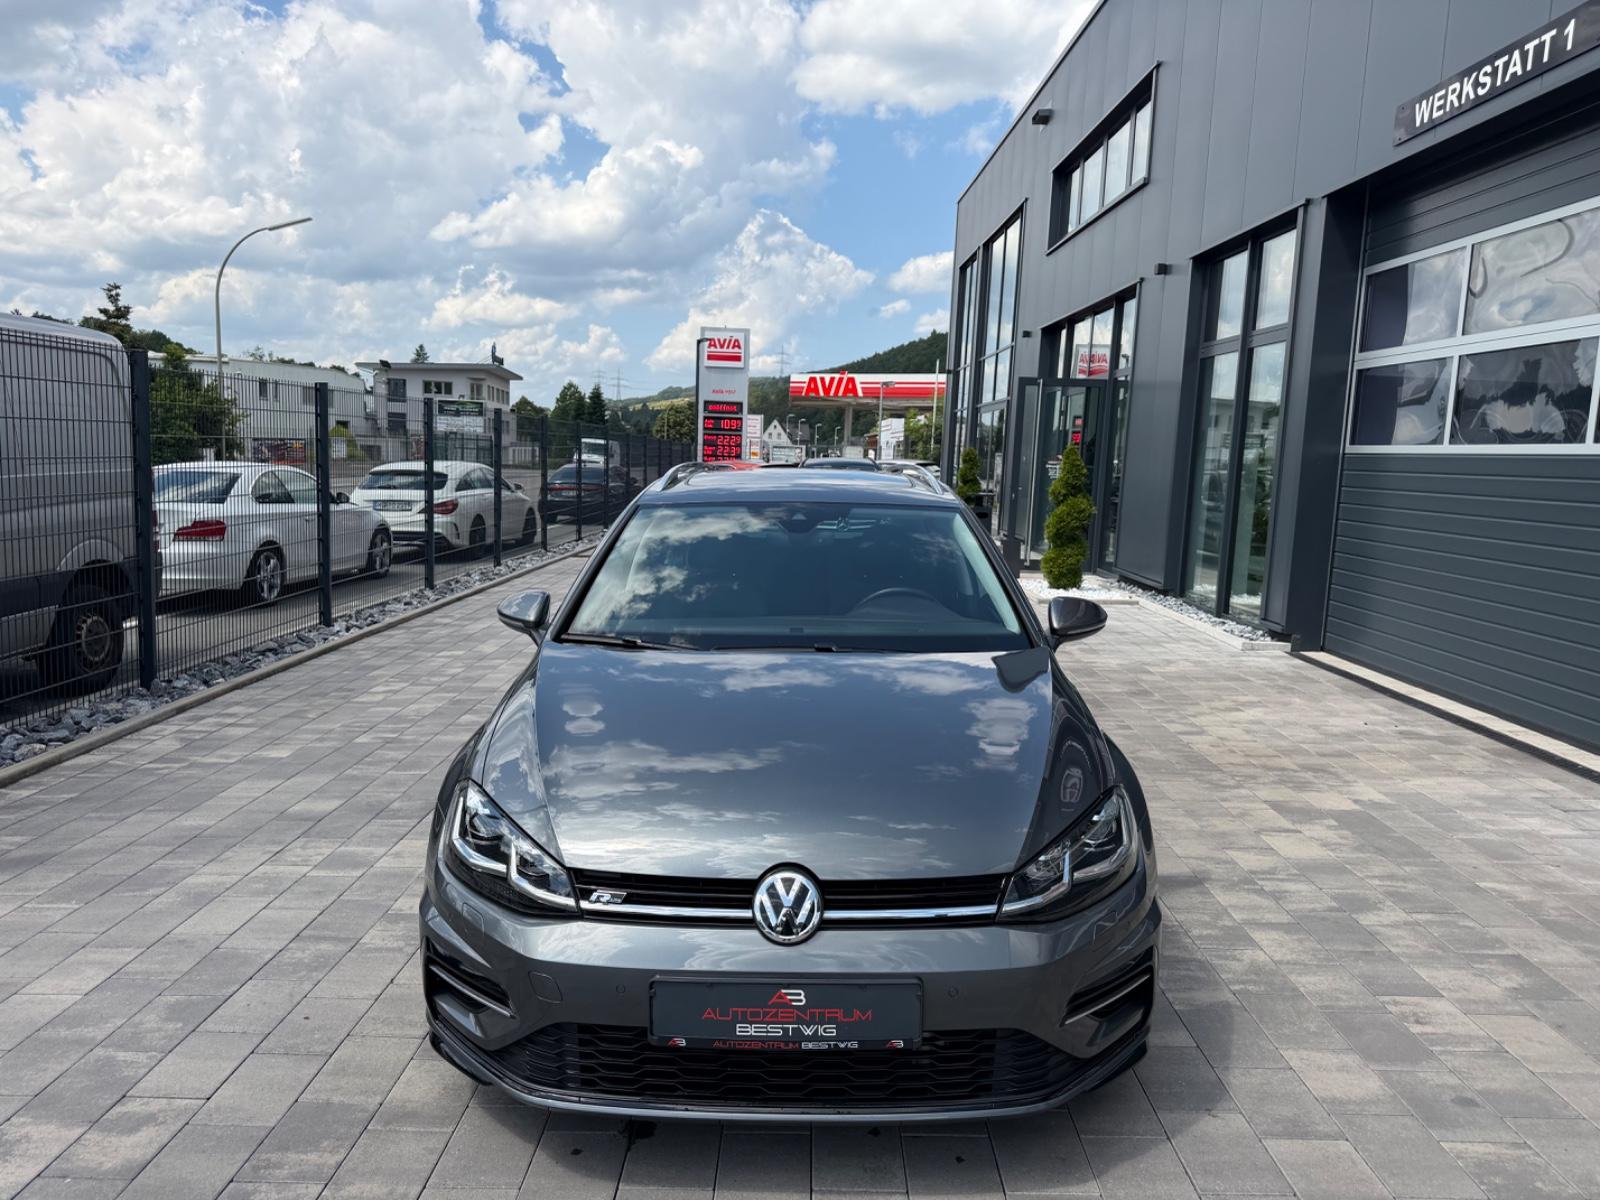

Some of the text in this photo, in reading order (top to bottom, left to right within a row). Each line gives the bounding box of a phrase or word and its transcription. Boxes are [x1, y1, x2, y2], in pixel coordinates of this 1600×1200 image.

[1415, 18, 1576, 128] WERKSTATT 1
[707, 336, 742, 350] AVIA
[804, 370, 861, 397] AVIA
[703, 1007, 872, 1022] AUTOZENTRUM
[736, 1023, 837, 1037] BESTWIG
[713, 1040, 859, 1050] AUTOZENTRUM BESTWIG
